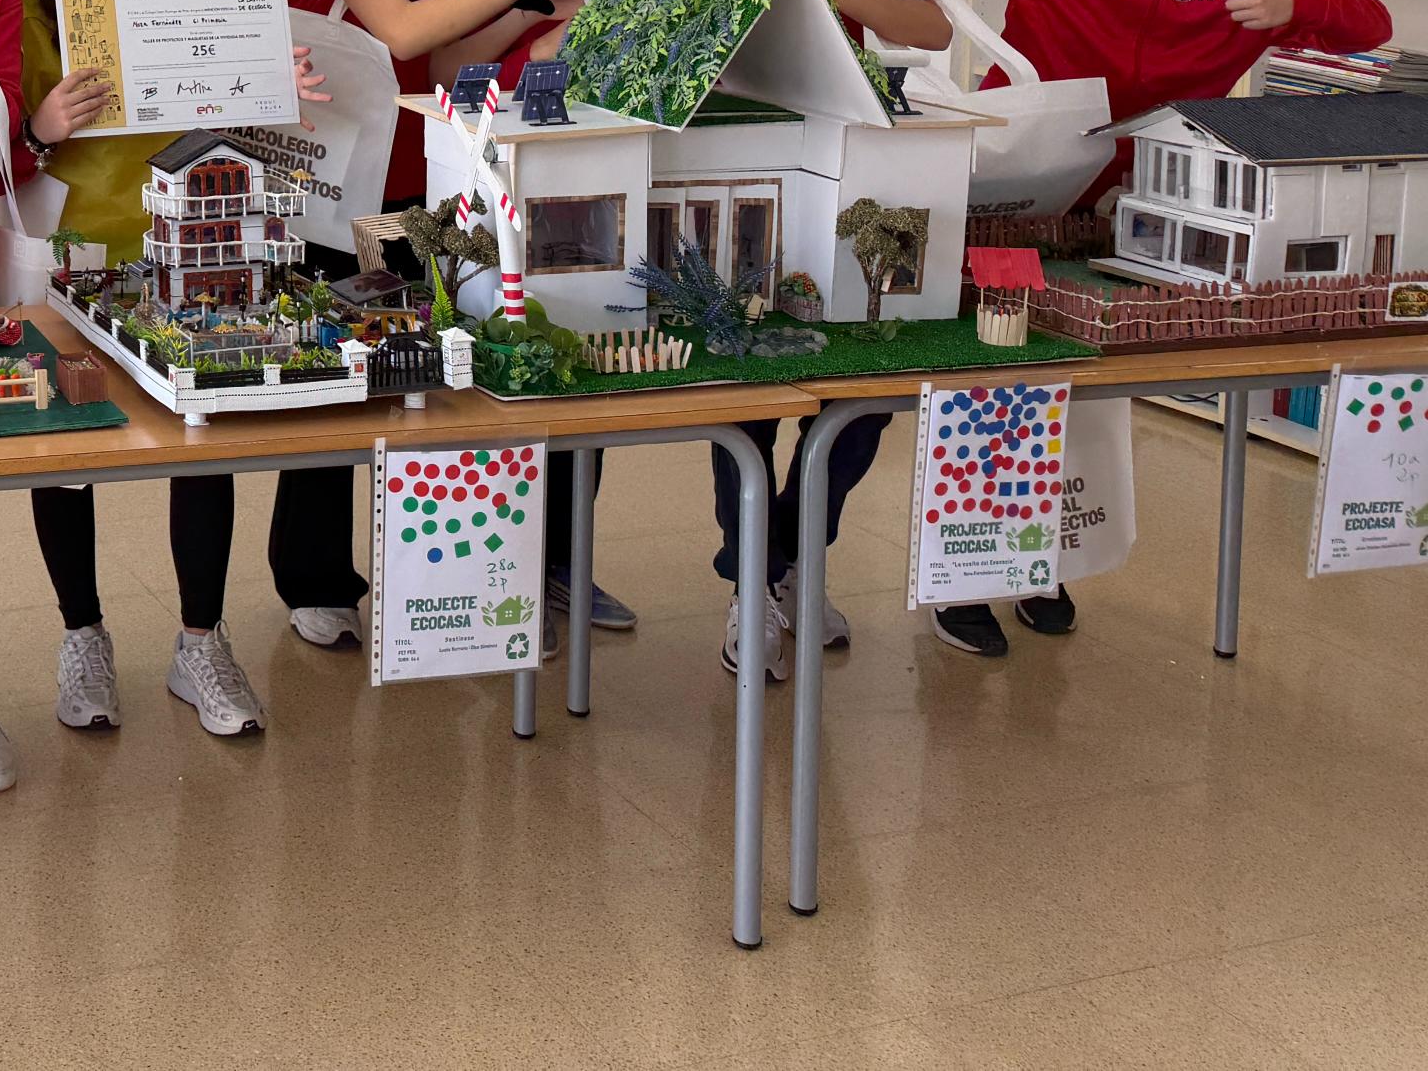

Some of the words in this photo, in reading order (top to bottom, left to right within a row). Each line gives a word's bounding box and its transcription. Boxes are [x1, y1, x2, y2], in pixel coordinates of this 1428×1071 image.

[192, 44, 216, 56] 25€
[1342, 501, 1404, 516] PROJECTE
[940, 521, 1003, 538] PROJECTE
[1345, 516, 1396, 531] ECOCASA
[944, 539, 997, 555] ECOCASA
[405, 595, 478, 613] PROJECTE
[411, 614, 471, 632] ECOCASA
